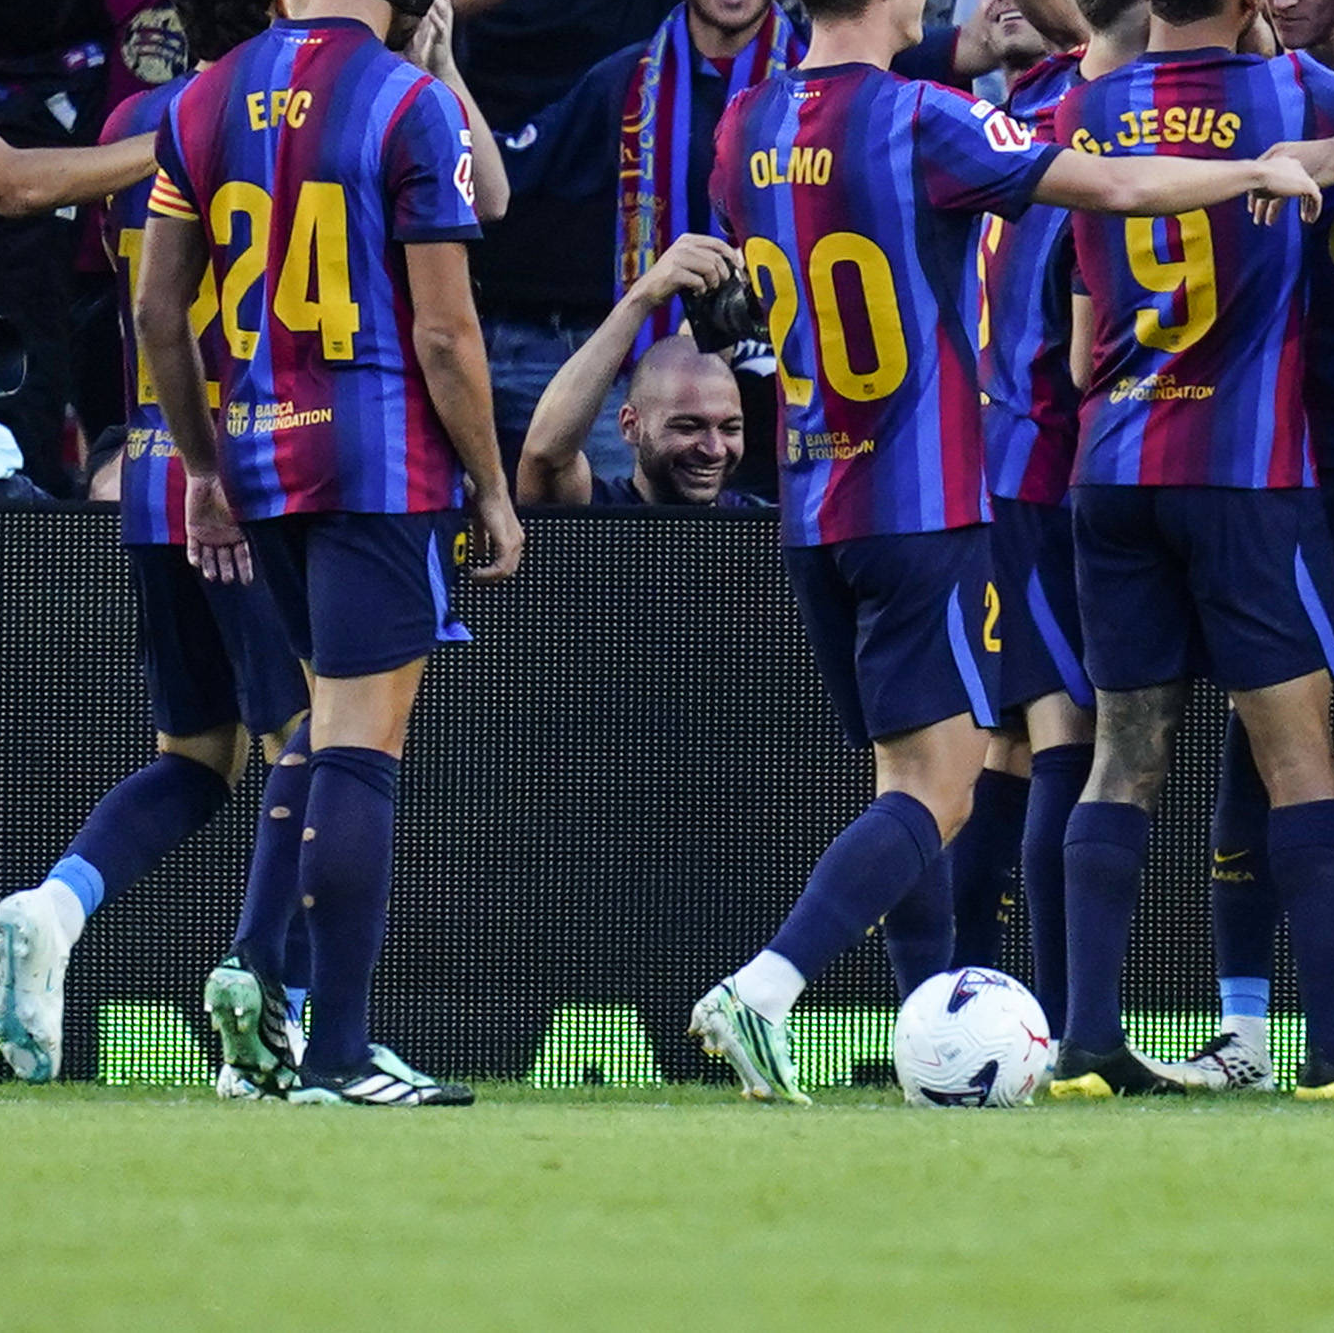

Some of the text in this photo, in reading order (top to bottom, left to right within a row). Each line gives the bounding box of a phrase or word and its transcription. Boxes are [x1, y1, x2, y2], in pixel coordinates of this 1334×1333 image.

[1071, 107, 1241, 156] G. JESUS
[750, 146, 833, 189] OLMO
[209, 181, 360, 360] 24
[1125, 208, 1217, 353] 9
[744, 232, 908, 407] 20
[253, 409, 332, 433] FOUNDATION
[1129, 385, 1216, 401] FOUNDATION
[983, 581, 1002, 653] 2
